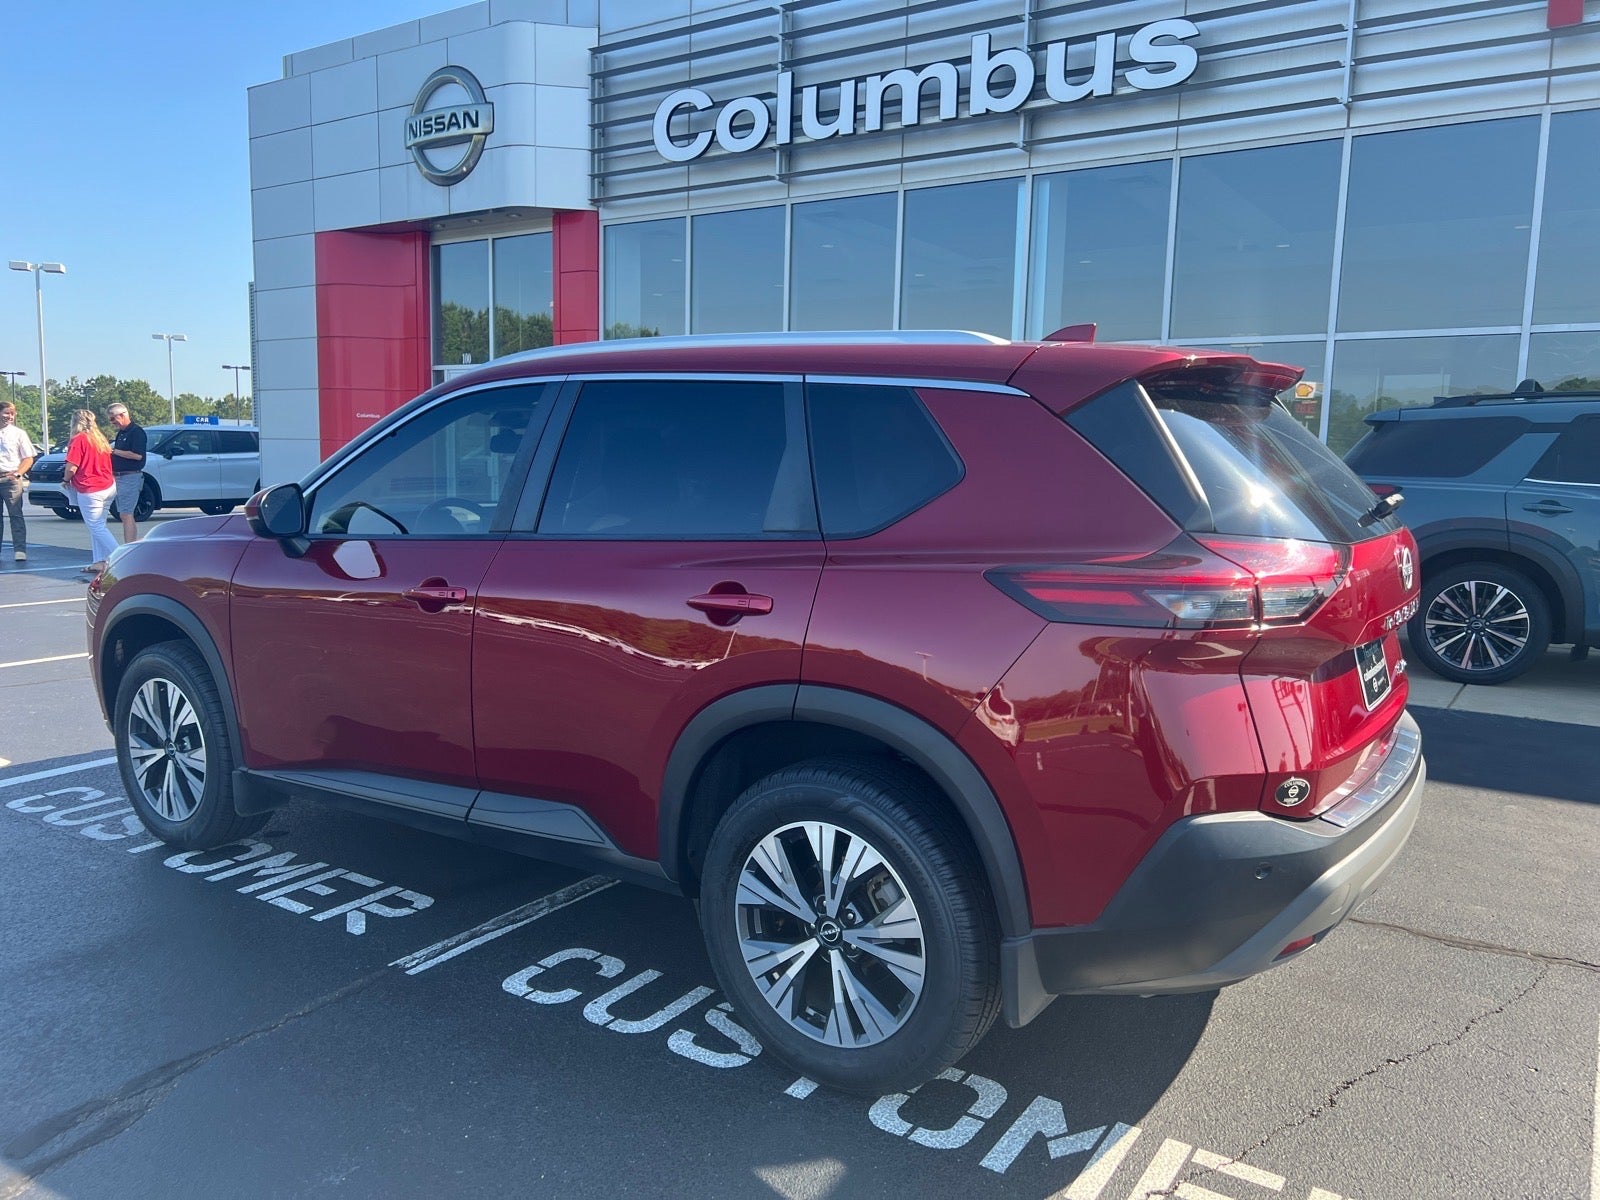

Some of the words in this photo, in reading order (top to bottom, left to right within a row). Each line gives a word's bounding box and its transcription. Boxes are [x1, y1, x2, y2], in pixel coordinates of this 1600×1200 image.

[408, 109, 479, 140] NISSAN
[652, 18, 1200, 163] Columbus
[502, 947, 1352, 1200] CUSOME
